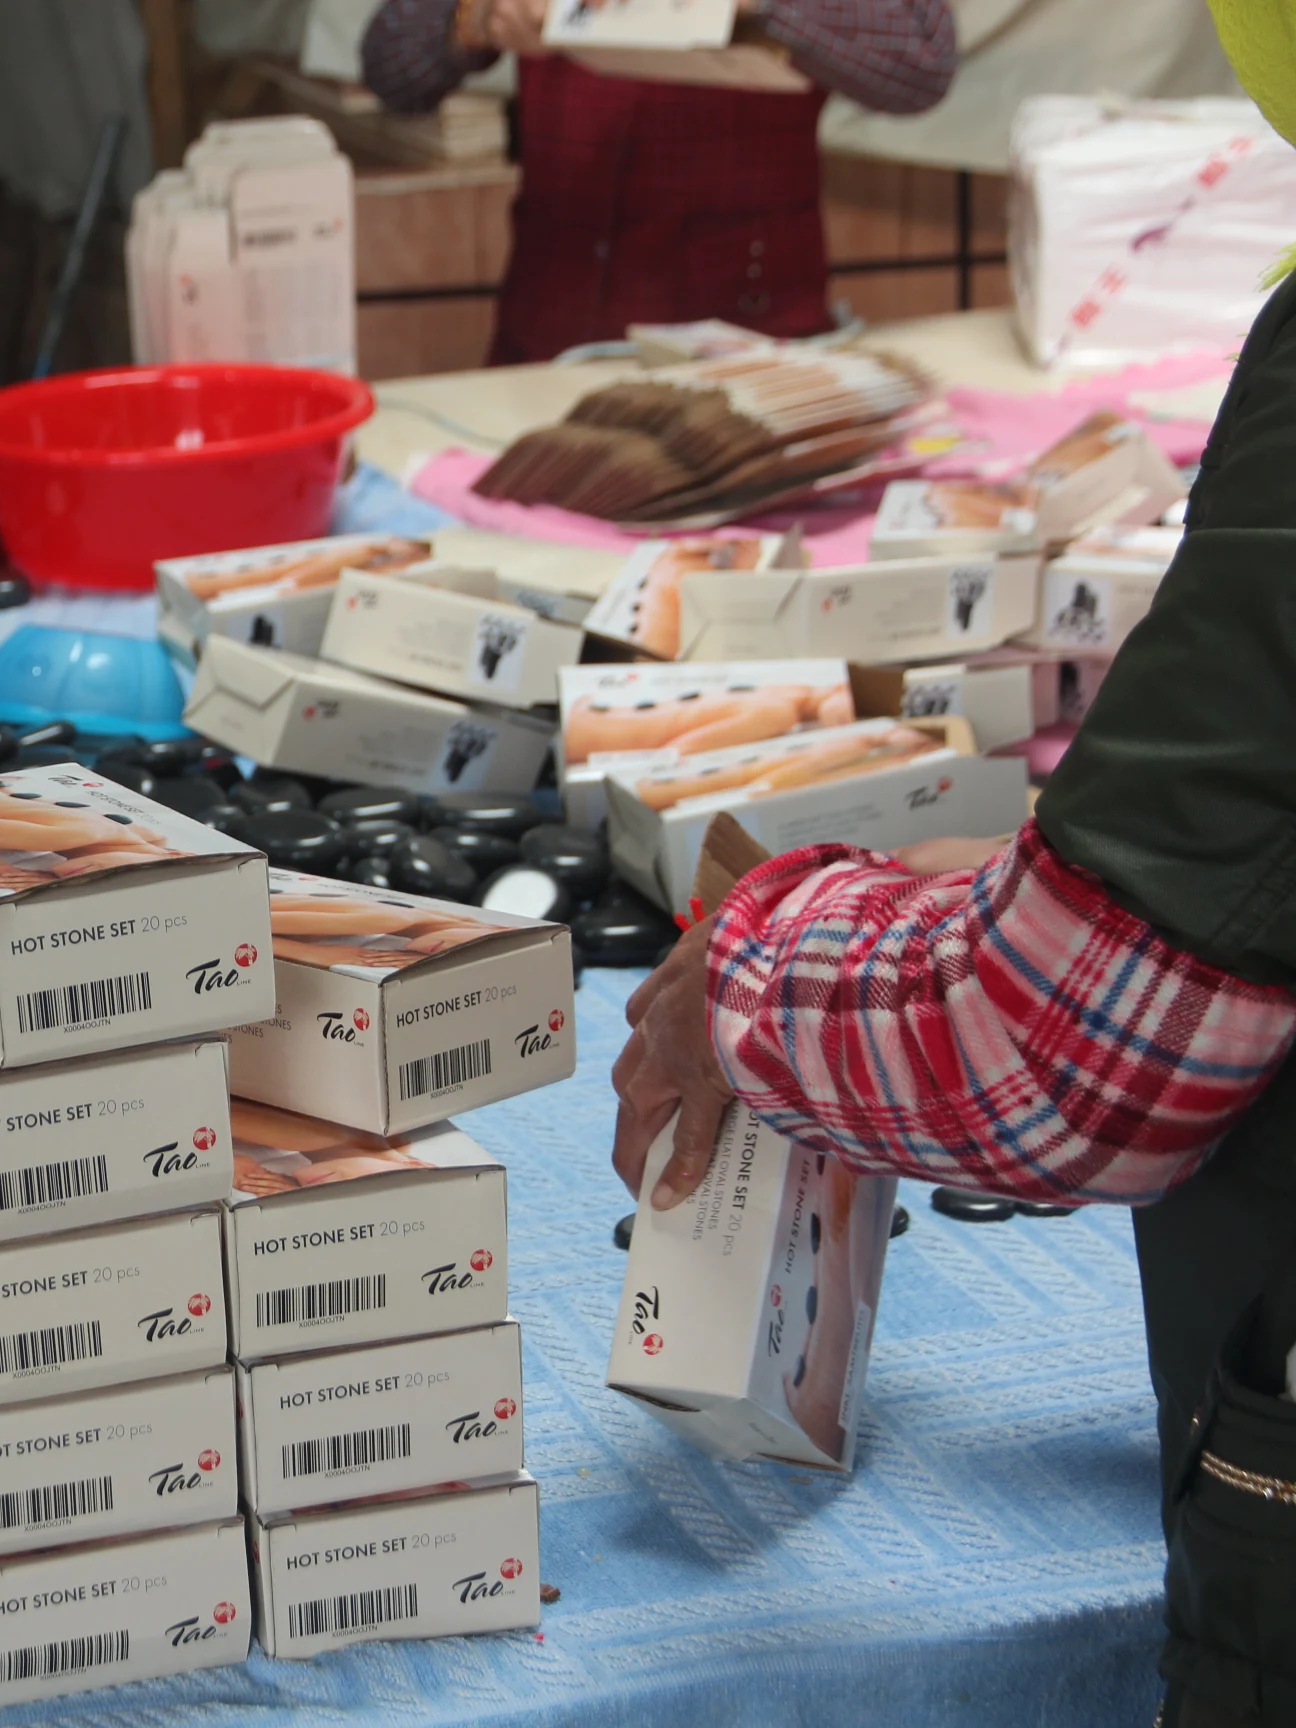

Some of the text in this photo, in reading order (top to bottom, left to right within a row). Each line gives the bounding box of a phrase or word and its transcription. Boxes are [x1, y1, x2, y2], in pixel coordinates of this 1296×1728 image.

[11, 915, 187, 955] HOT STONE SET 20 pcs
[186, 958, 238, 994] Tao
[396, 986, 517, 1028] HOT STONE SET 20 pcs
[317, 1013, 356, 1042] Tao
[515, 1024, 551, 1058] Tao
[7, 1109, 61, 1132] STONE
[67, 1103, 93, 1121] SET
[98, 1100, 116, 1116] 20
[121, 1098, 144, 1116] pcs
[143, 1142, 197, 1177] Tao
[716, 1161, 729, 1187] OVAL
[736, 1132, 757, 1182] STONE
[707, 1190, 725, 1230] STONES
[731, 1186, 749, 1210] SET
[254, 1220, 425, 1255] HOT STONE SET 20 pcs
[692, 1200, 710, 1242] STONES
[728, 1214, 743, 1232] 20
[784, 1242, 796, 1274] HOT
[790, 1187, 805, 1238] STONE
[722, 1234, 737, 1257] pcs
[2, 1276, 56, 1298] STONE
[62, 1271, 88, 1287] SET
[93, 1267, 112, 1283] 20
[117, 1267, 140, 1283] pcs
[421, 1263, 472, 1295] Tao
[138, 1308, 192, 1342] Tao
[632, 1285, 659, 1335] Tao
[280, 1371, 449, 1409] HOT STONE SET 20 pcs
[16, 1434, 70, 1455] STONE
[76, 1429, 101, 1444] SET
[107, 1424, 125, 1440] 20
[130, 1423, 152, 1440] pcs
[446, 1411, 497, 1443] Tao
[149, 1463, 201, 1496] Tao
[287, 1533, 456, 1570] HOT STONE SET 20 pcs
[33, 1587, 86, 1608] STONE
[91, 1581, 117, 1597] SET
[122, 1577, 140, 1593] 20
[145, 1576, 167, 1593] pcs
[452, 1571, 504, 1603] Tao
[165, 1616, 216, 1647] Tao
